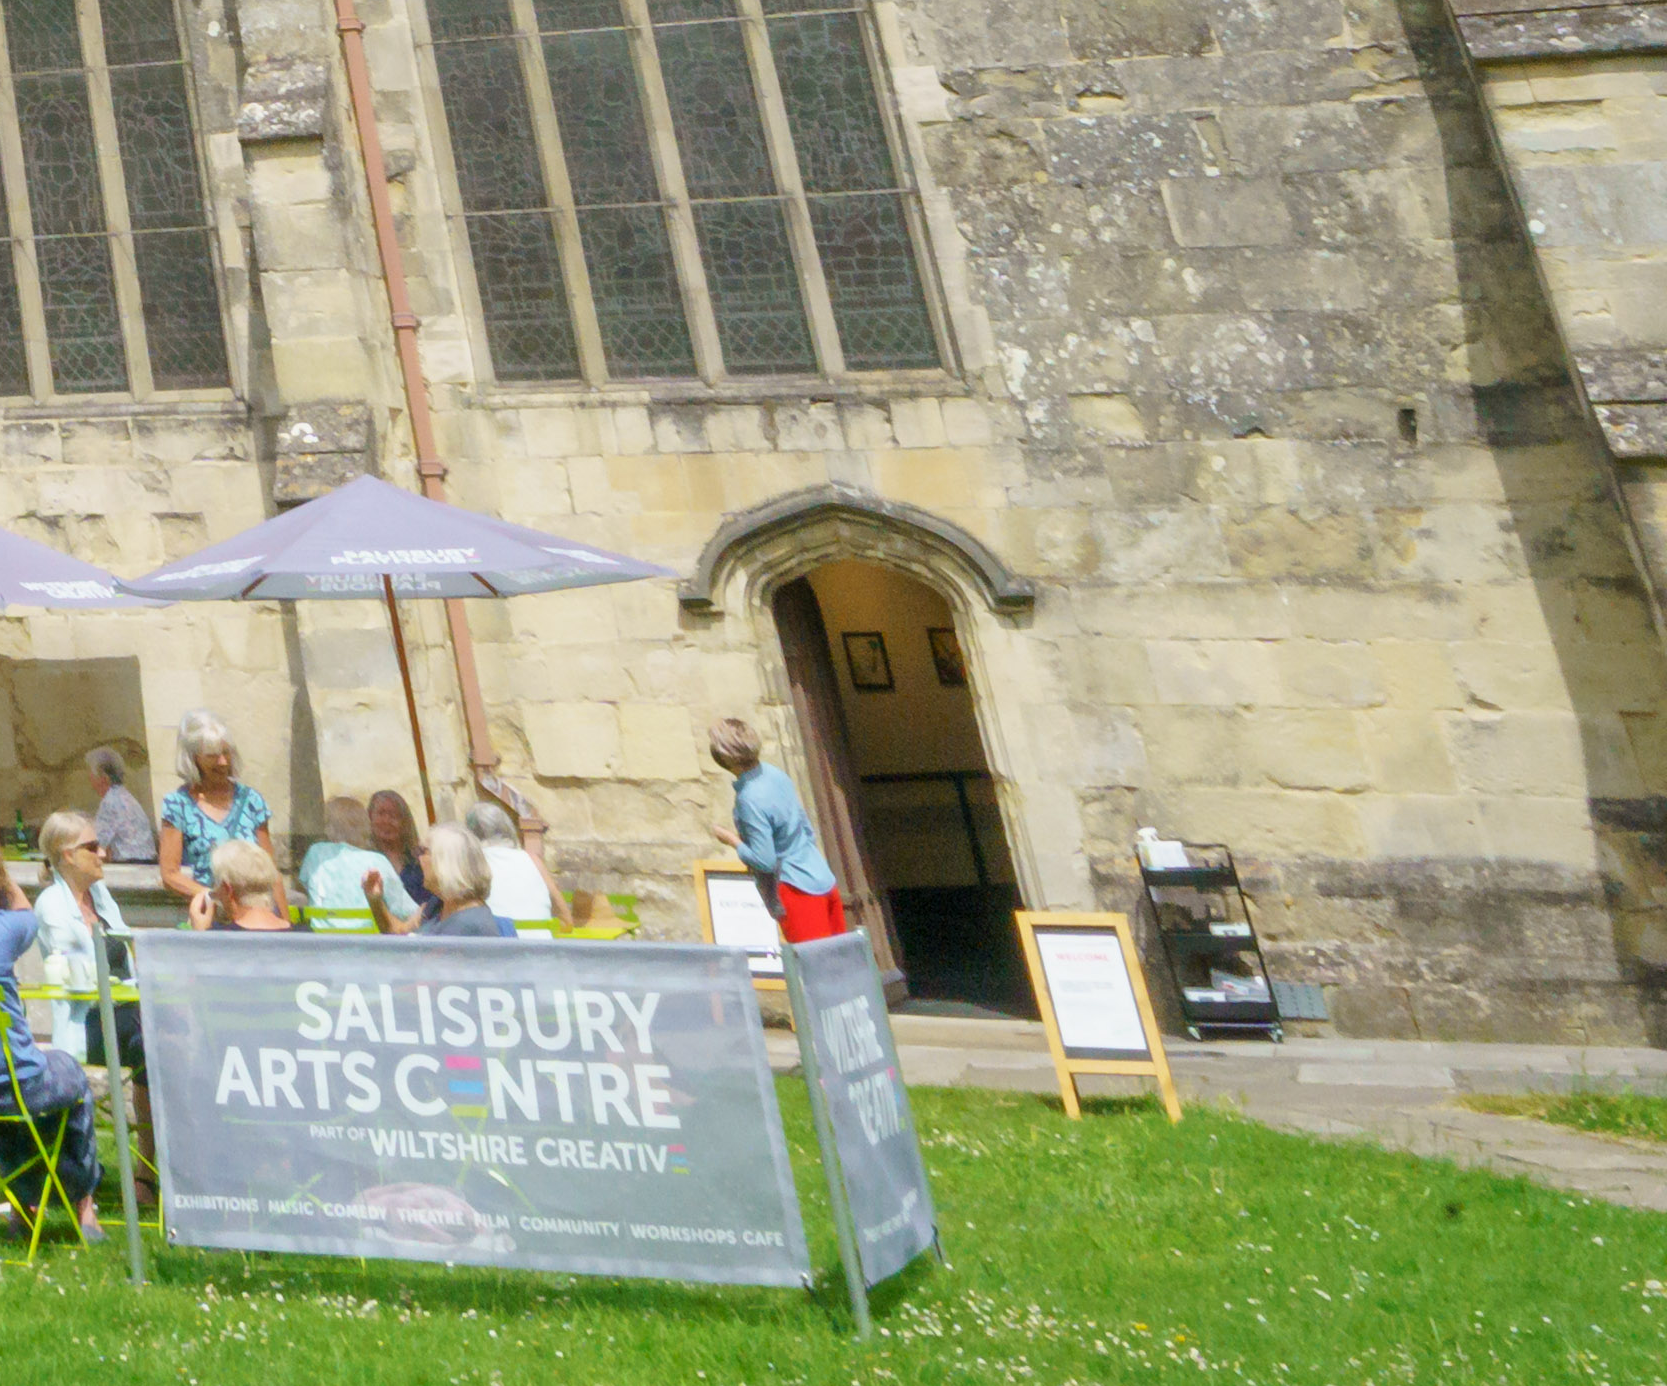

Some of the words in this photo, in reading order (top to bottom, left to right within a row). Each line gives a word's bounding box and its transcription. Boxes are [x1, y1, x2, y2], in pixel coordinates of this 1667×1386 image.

[295, 980, 661, 1055] SALISBURY
[215, 1045, 382, 1113] ARTS
[309, 1124, 345, 1140] PART
[347, 1126, 367, 1142] OF
[367, 1128, 529, 1165] WILTSHIRE
[174, 1194, 259, 1212] EXHIBITIONS
[268, 1199, 314, 1215] MUSIC
[323, 1202, 388, 1221] COMEDY
[397, 1207, 465, 1226] THEATRE
[474, 1211, 511, 1229] FILM
[519, 1216, 620, 1237] COMMUNITY
[630, 1223, 737, 1245] WORKSHOPS
[742, 1230, 786, 1247] CAFE
